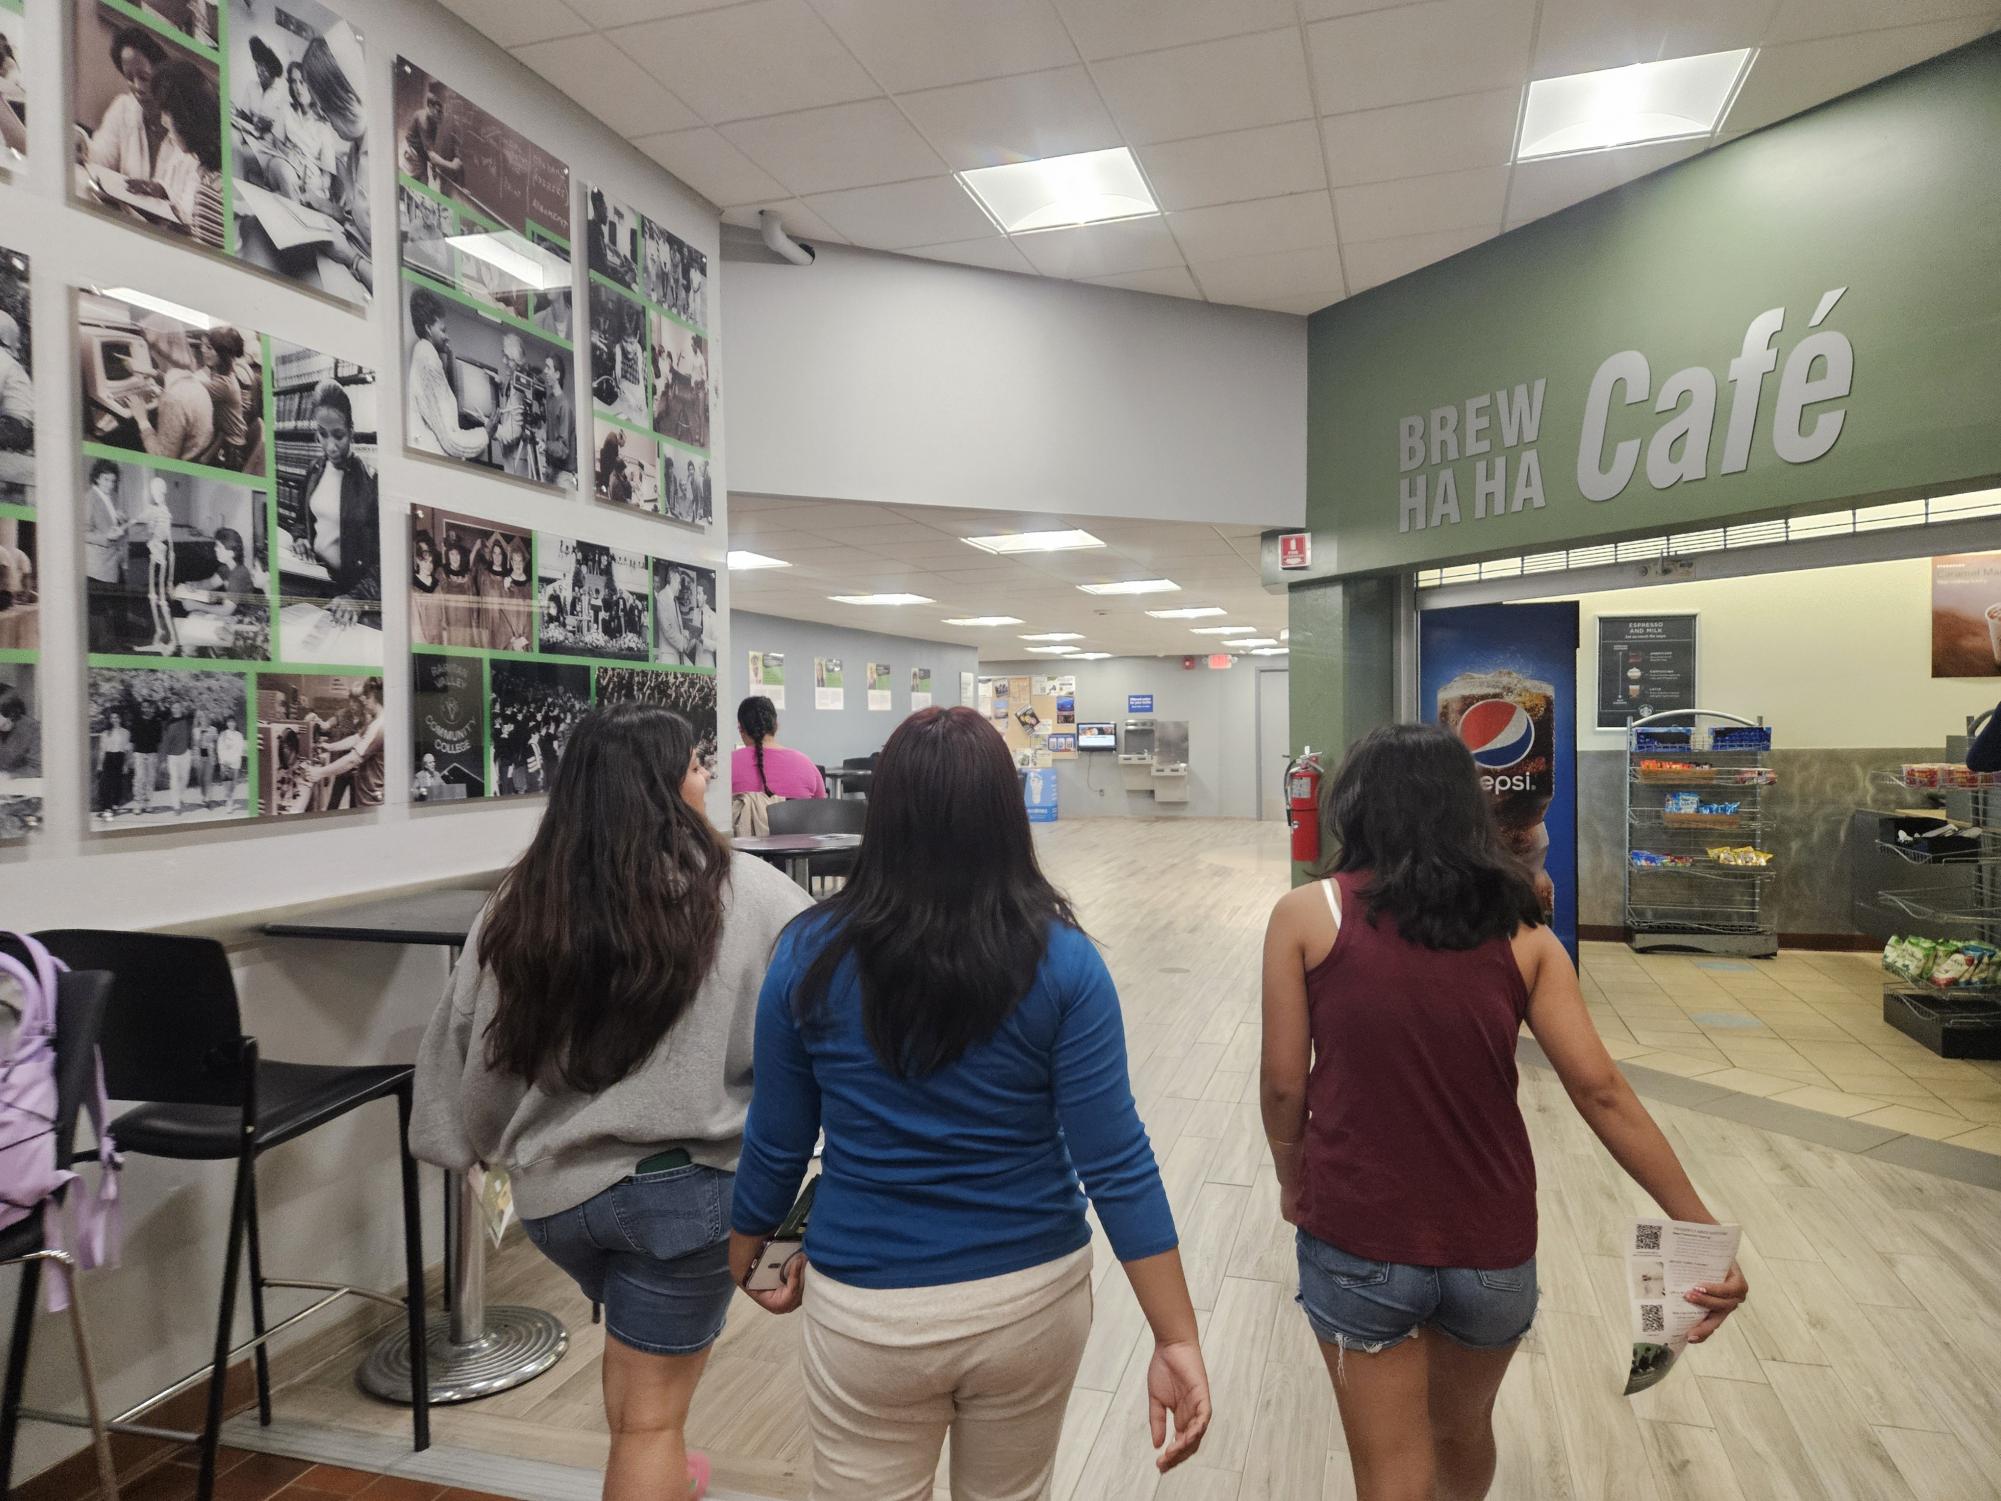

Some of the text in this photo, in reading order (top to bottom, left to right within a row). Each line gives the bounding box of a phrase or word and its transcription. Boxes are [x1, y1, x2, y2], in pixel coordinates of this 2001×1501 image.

[1577, 286, 1855, 502] Café
[1400, 377, 1547, 473] BREW
[1400, 448, 1546, 533] HA HA
[425, 715, 476, 741] COMMUNITY
[434, 739, 472, 754] COLLEGE
[1480, 771, 1530, 795] epsi
